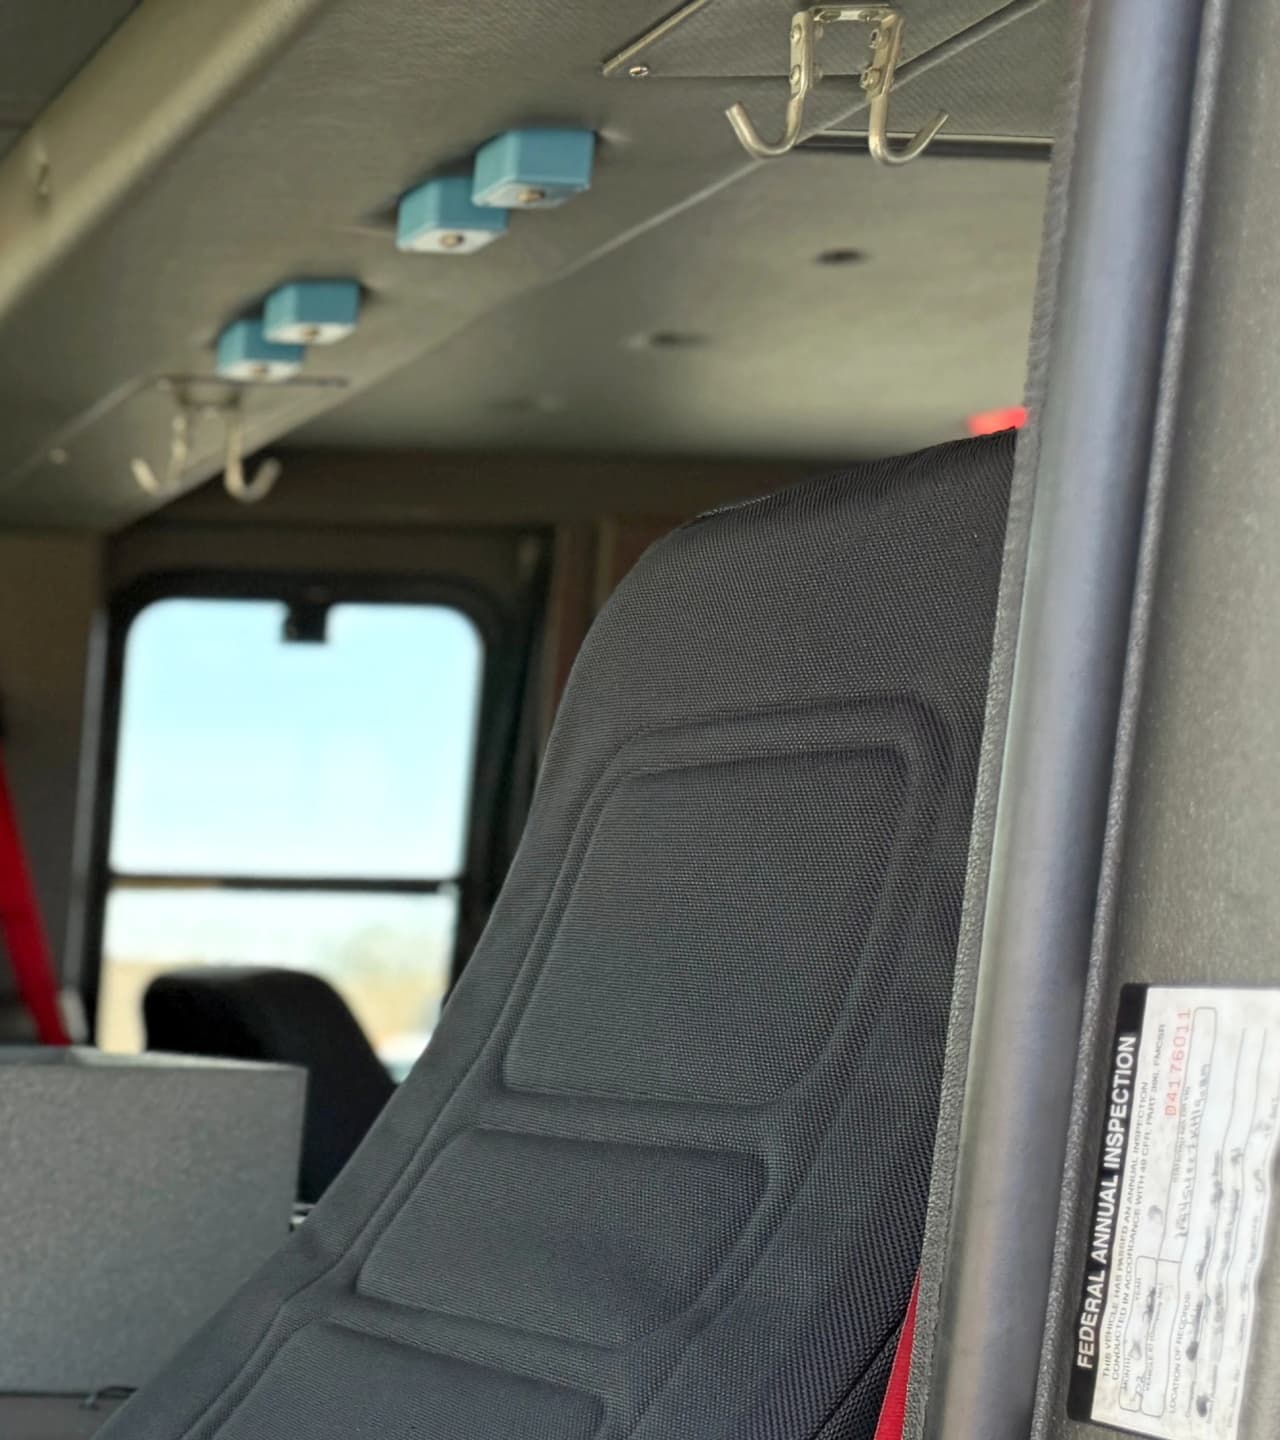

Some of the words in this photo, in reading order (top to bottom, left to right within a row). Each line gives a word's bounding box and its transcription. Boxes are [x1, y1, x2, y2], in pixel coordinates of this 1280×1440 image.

[1103, 1033, 1136, 1170] INSPECTION
[1090, 1171, 1118, 1264] ANNUAL
[1102, 1300, 1118, 1350] VEHICLE
[1125, 1156, 1138, 1203] ANNUAL
[1132, 1080, 1148, 1153] INSPECTION
[1075, 1266, 1105, 1369] FEDERAL
[1109, 1305, 1127, 1381] CONDUCTED
[1123, 1208, 1141, 1290] ACCORDANCE
[1135, 1175, 1145, 1206] WITH
[1167, 1362, 1182, 1414] LOCATION
